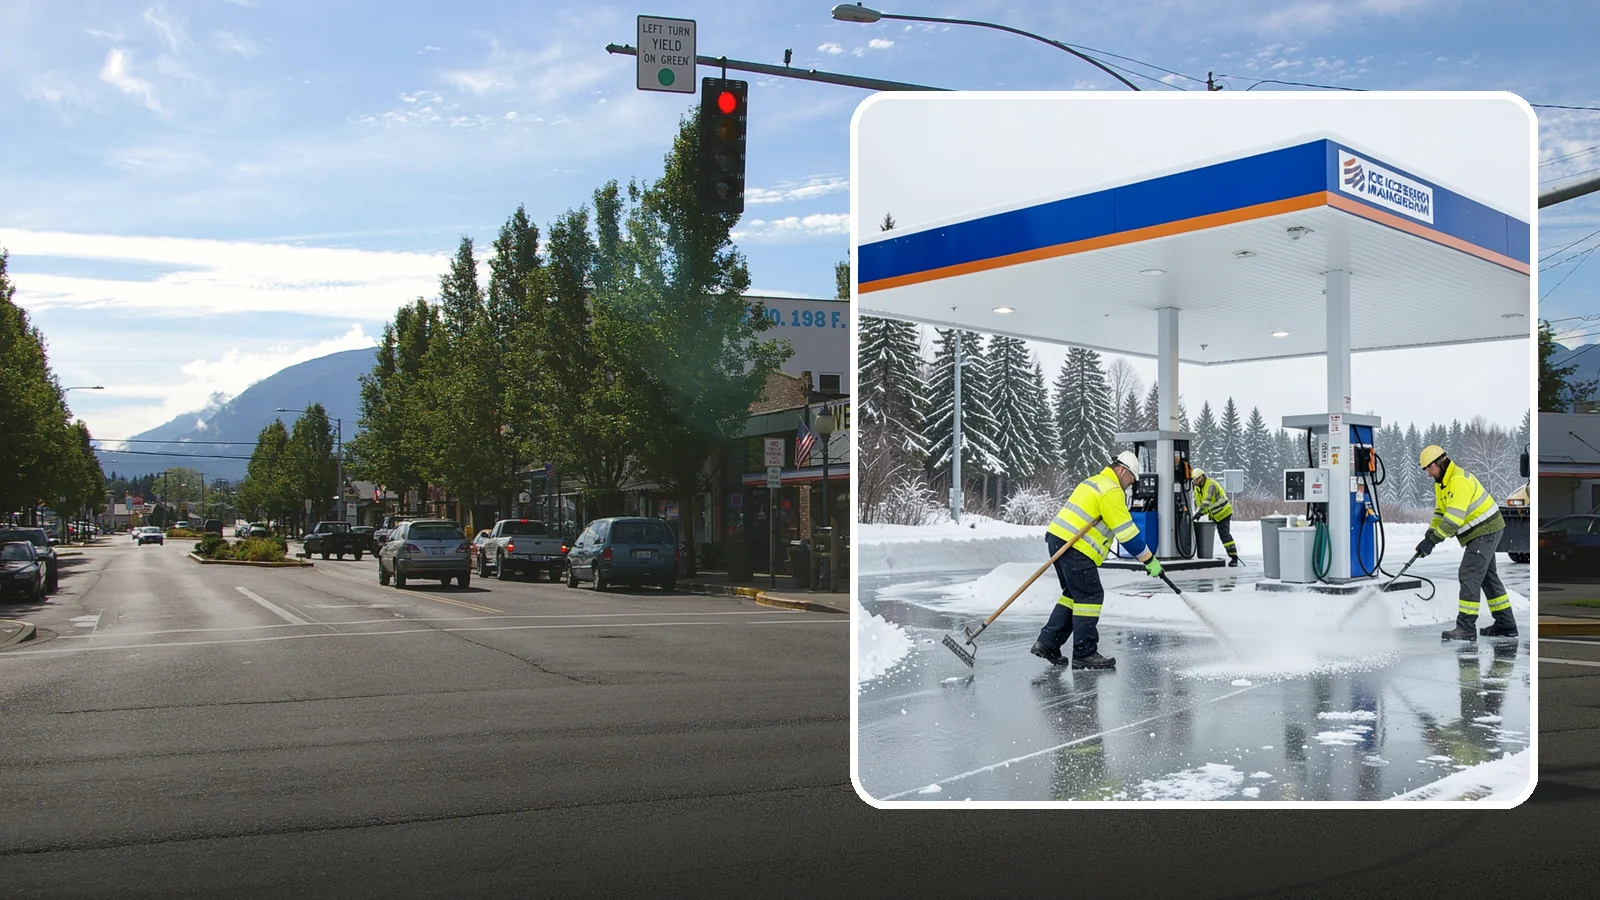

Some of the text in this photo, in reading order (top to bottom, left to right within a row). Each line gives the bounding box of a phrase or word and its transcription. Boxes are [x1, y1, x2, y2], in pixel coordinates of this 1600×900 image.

[642, 23, 690, 36] LEFT TURN
[652, 37, 682, 51] YIELD
[644, 53, 688, 66] ON GREEN
[791, 309, 826, 328] 198
[831, 311, 847, 329] F.
